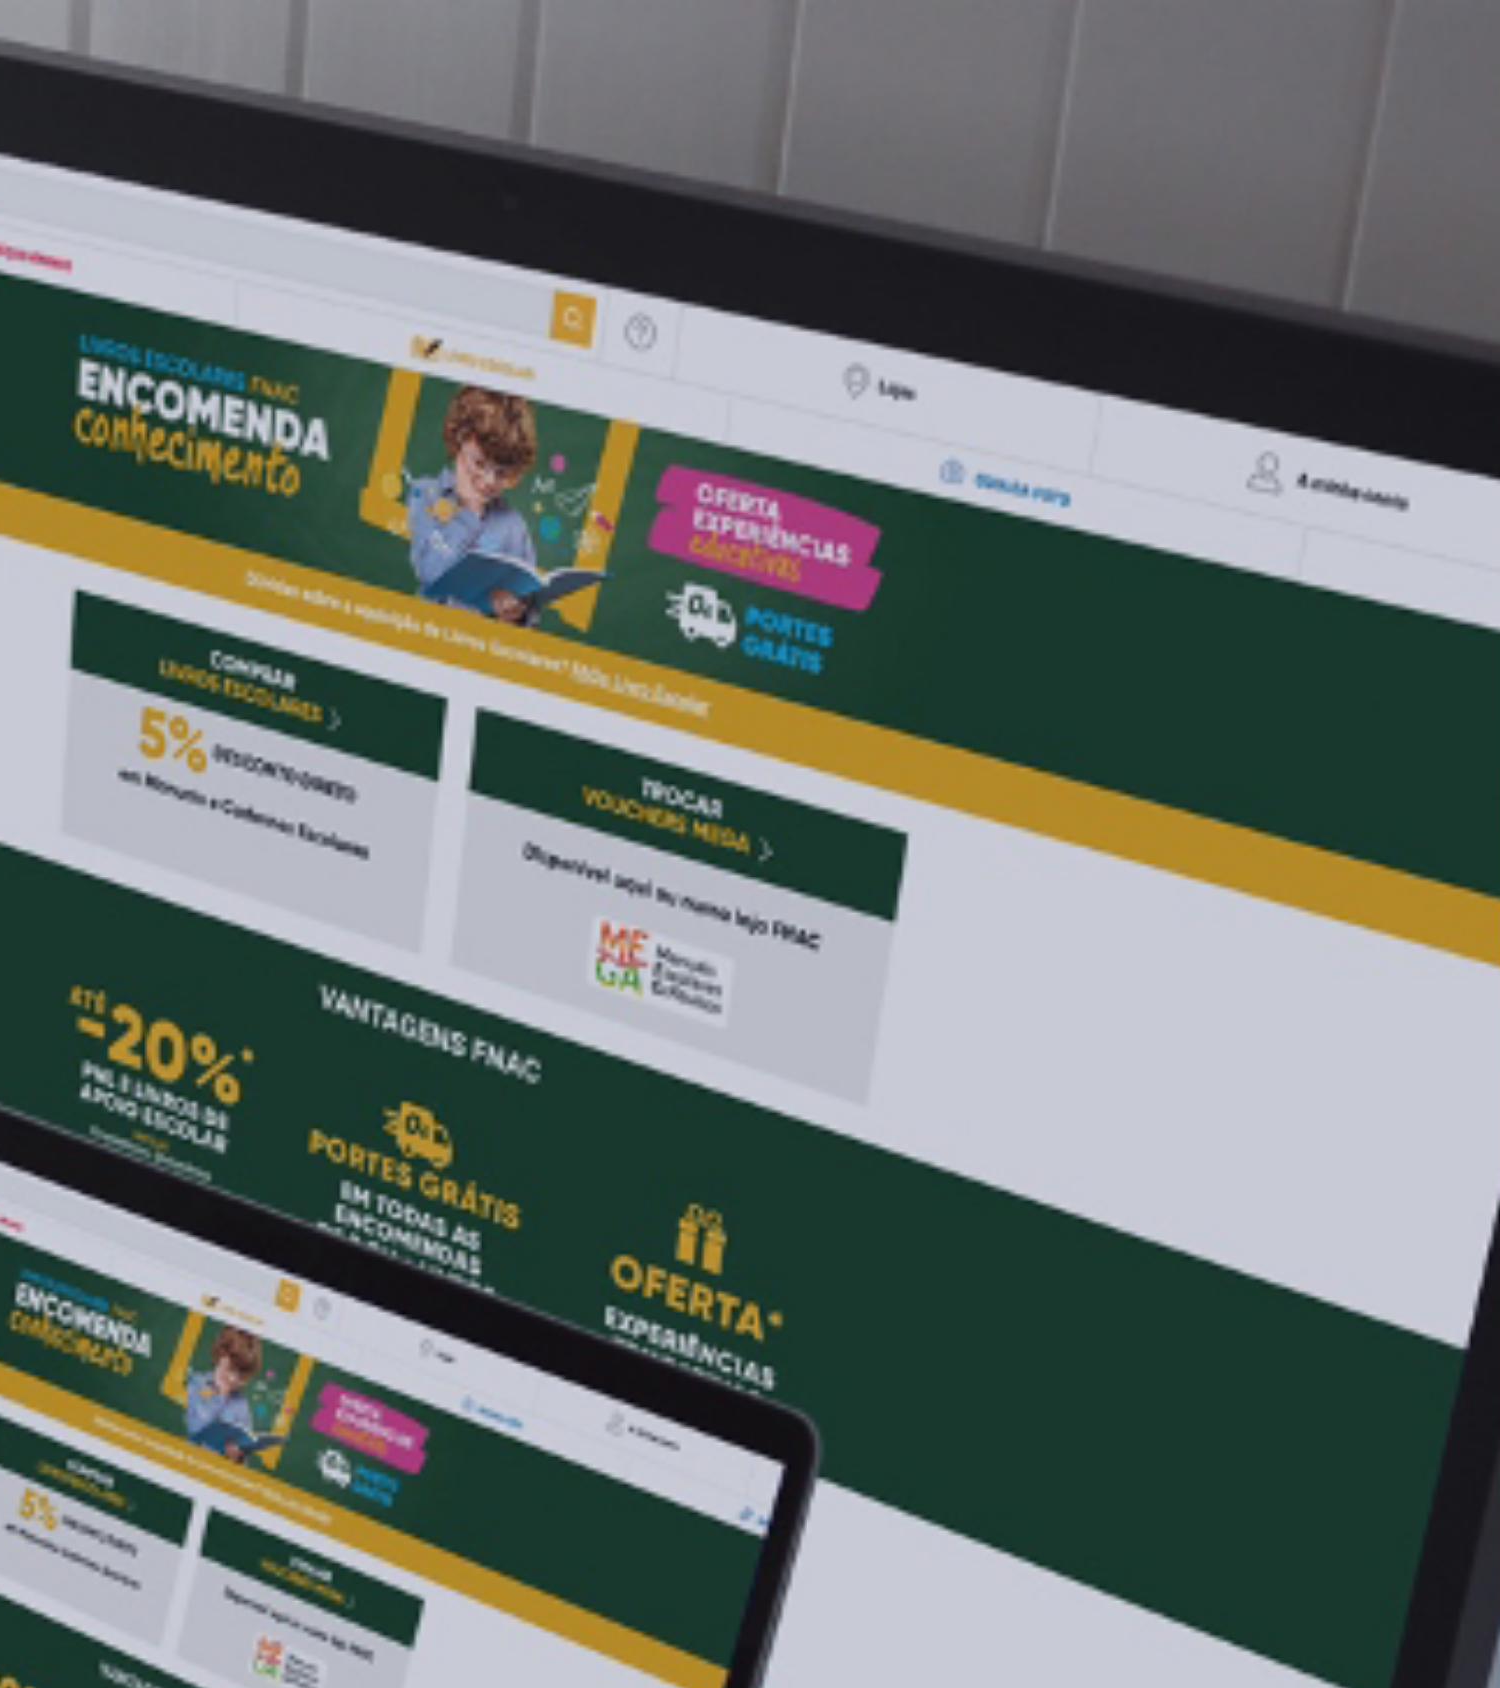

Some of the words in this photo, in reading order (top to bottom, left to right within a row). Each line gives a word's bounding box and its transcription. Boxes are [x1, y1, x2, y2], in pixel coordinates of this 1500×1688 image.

[77, 357, 330, 461] ENCOMENDA
[72, 404, 300, 496] conhecimento
[697, 482, 780, 519] OFERTA
[693, 507, 852, 567] EXPERIÊNCIAS
[741, 633, 823, 674] GRÁTIS
[745, 605, 834, 648] PORTES
[209, 650, 297, 691] COMPRAR
[138, 706, 208, 773] 5%
[640, 776, 724, 820] TROCAR
[318, 983, 468, 1059] VANTAGENS
[470, 1036, 543, 1086] FNAC
[307, 1129, 412, 1188] PORTES
[418, 1171, 523, 1230] GRÁTIS
[334, 1202, 483, 1277] ENCOMENDAS
[340, 1180, 370, 1210] EM
[374, 1188, 448, 1238] TODAS
[451, 1224, 482, 1251] AS
[603, 1305, 777, 1391] EXPERIÊNCIAS
